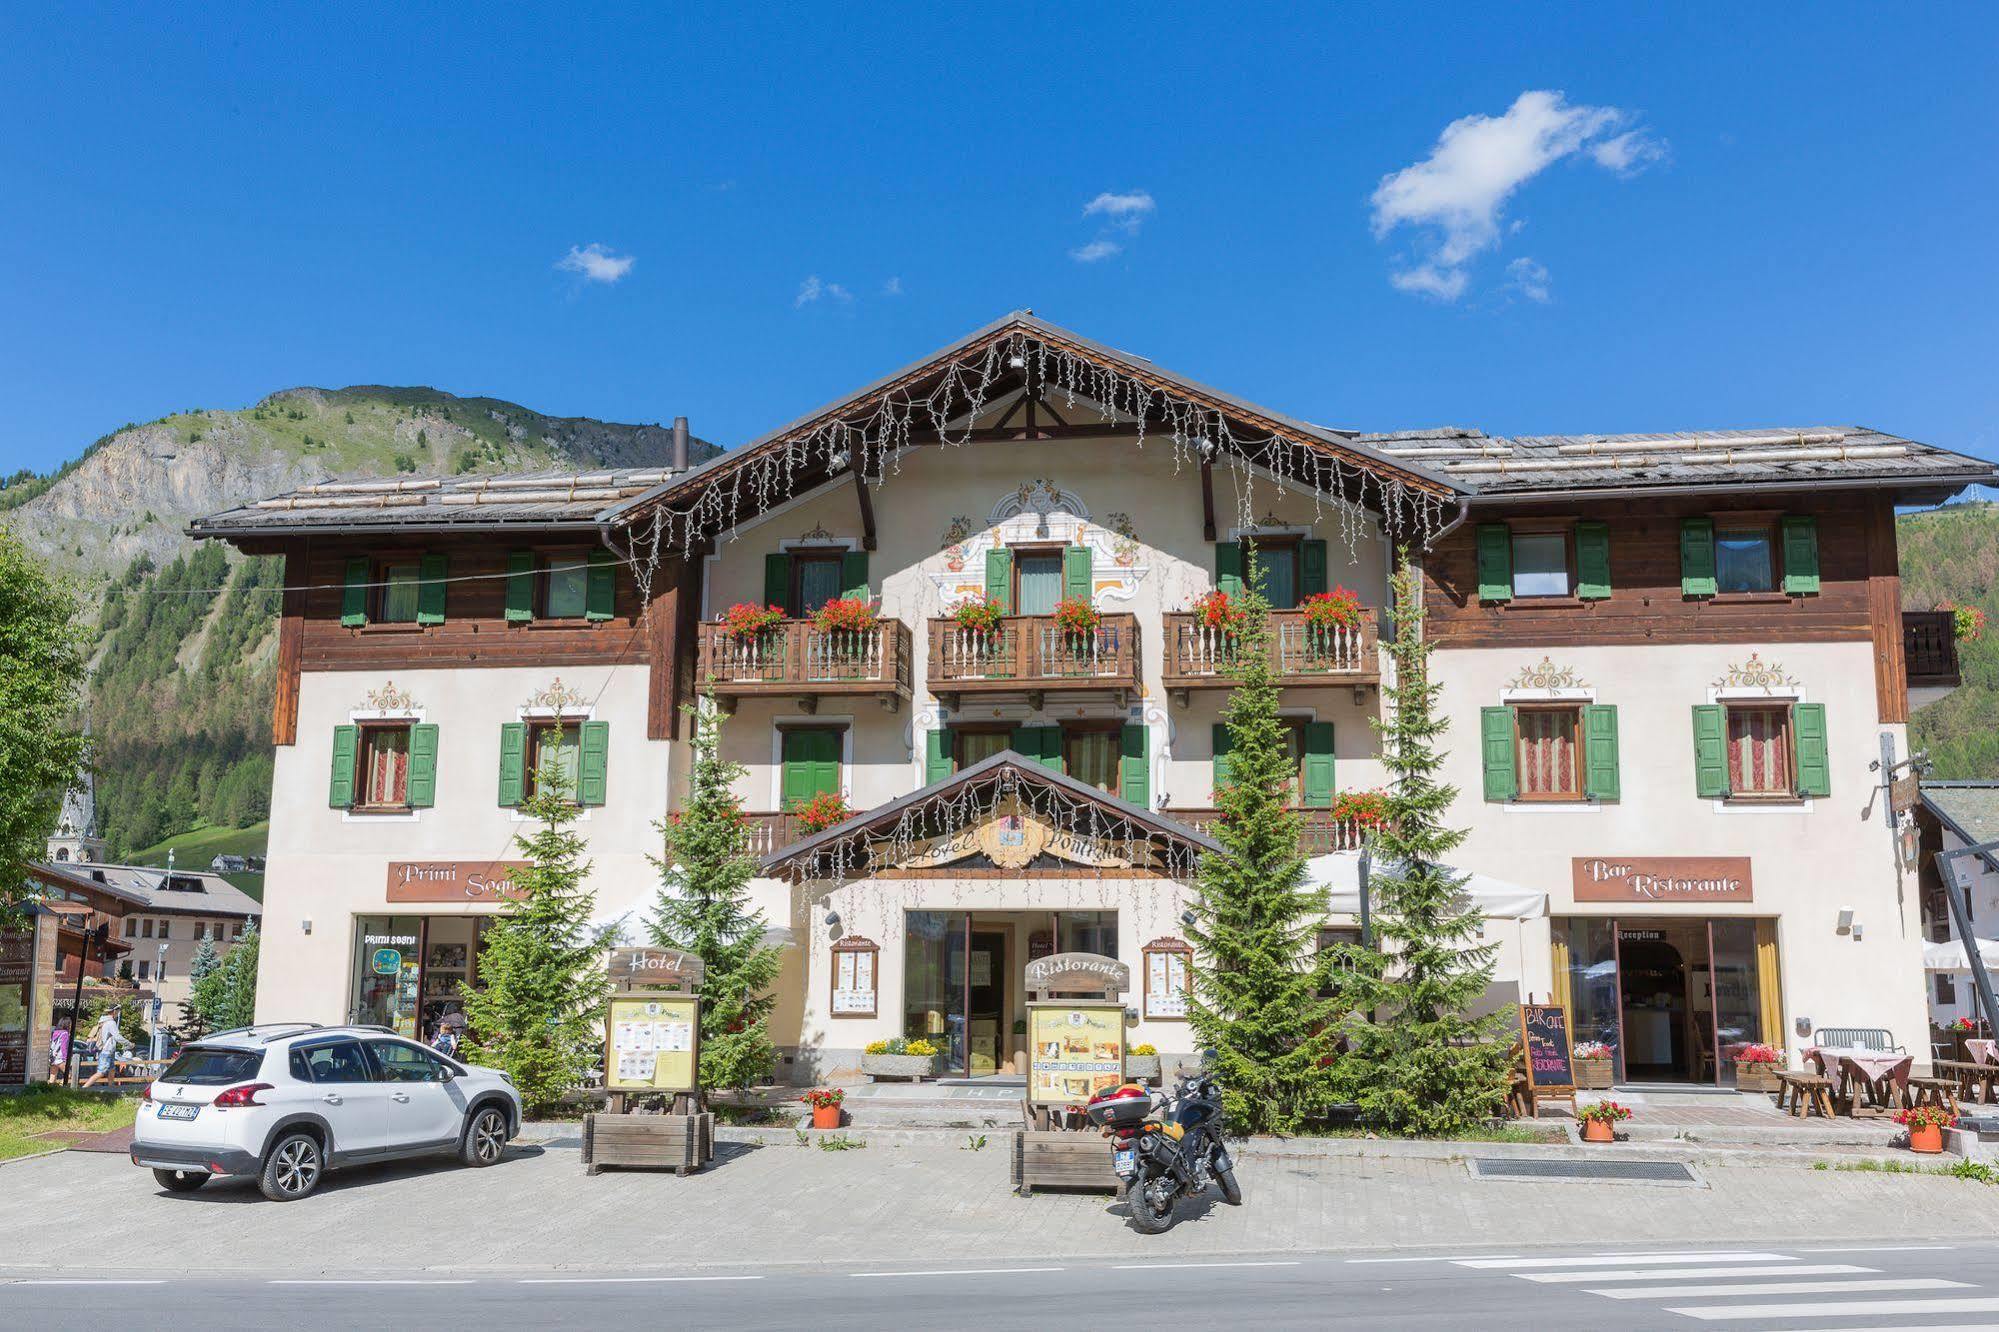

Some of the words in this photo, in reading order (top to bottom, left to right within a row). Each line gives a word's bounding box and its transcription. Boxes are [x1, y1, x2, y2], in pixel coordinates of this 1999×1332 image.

[397, 864, 456, 888] Primi
[1584, 859, 1632, 882] Bar
[465, 873, 522, 897] Sogn
[1626, 874, 1742, 898] Ristorante
[1617, 930, 1660, 940] Reception
[628, 951, 684, 972] Hotel
[1030, 957, 1124, 980] Ristorante
[1525, 1008, 1546, 1026] BAR
